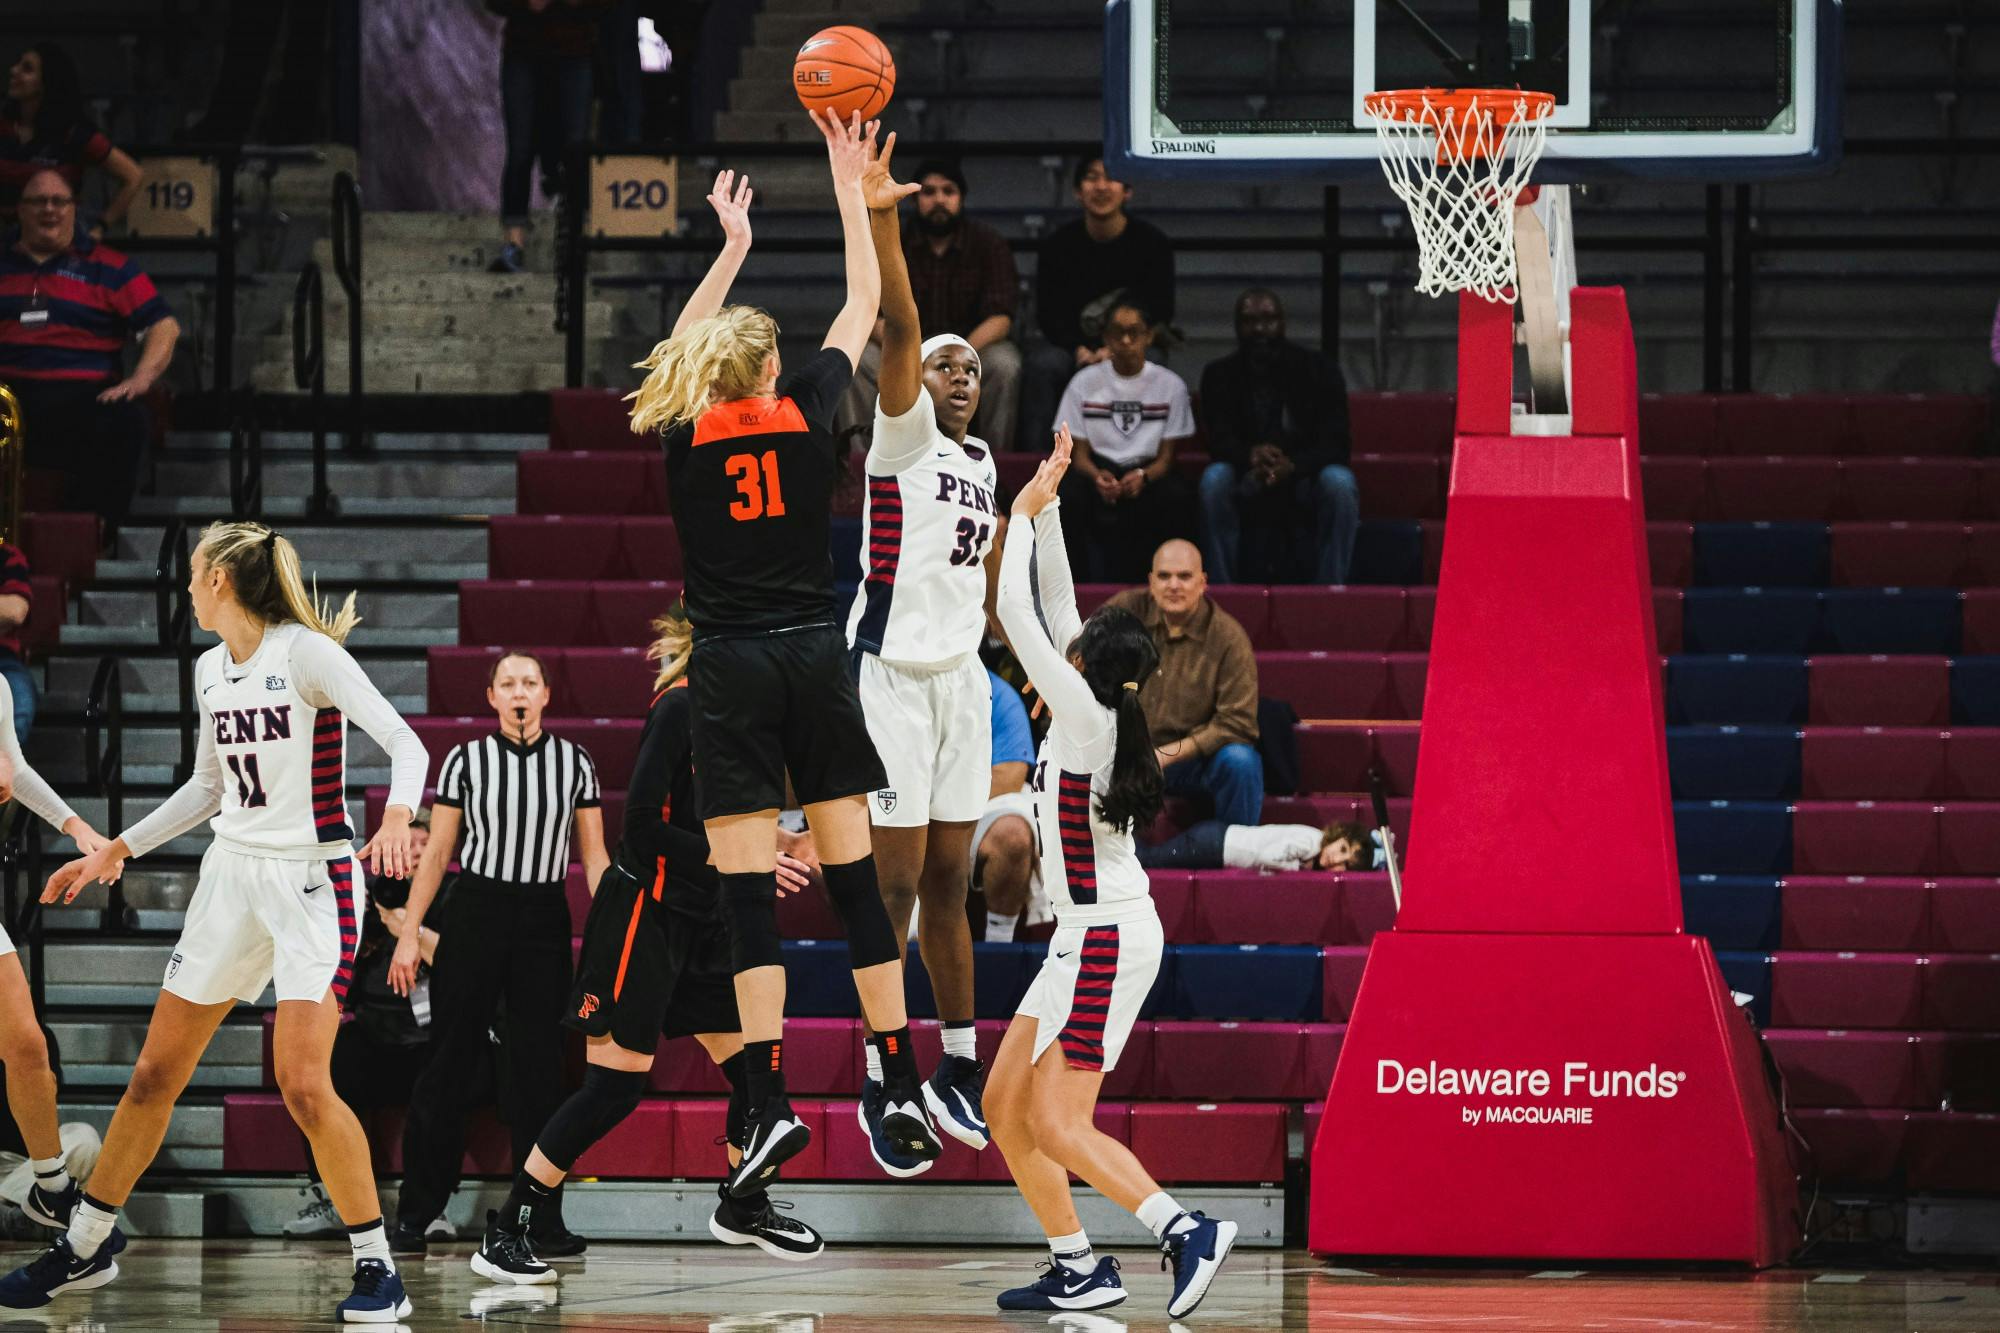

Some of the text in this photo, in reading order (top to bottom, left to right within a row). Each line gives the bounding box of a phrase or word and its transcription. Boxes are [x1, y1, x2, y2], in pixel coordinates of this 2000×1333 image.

[1151, 139, 1216, 155] SPALDING
[146, 181, 194, 210] 119
[605, 179, 669, 211] 120
[725, 450, 785, 521] 31
[949, 516, 990, 567] 31
[210, 704, 292, 745] ENN
[226, 753, 267, 808] 11
[884, 799, 893, 810] P
[1376, 1059, 1551, 1097] Delaware
[1461, 1106, 1593, 1126] by MACQUARIE
